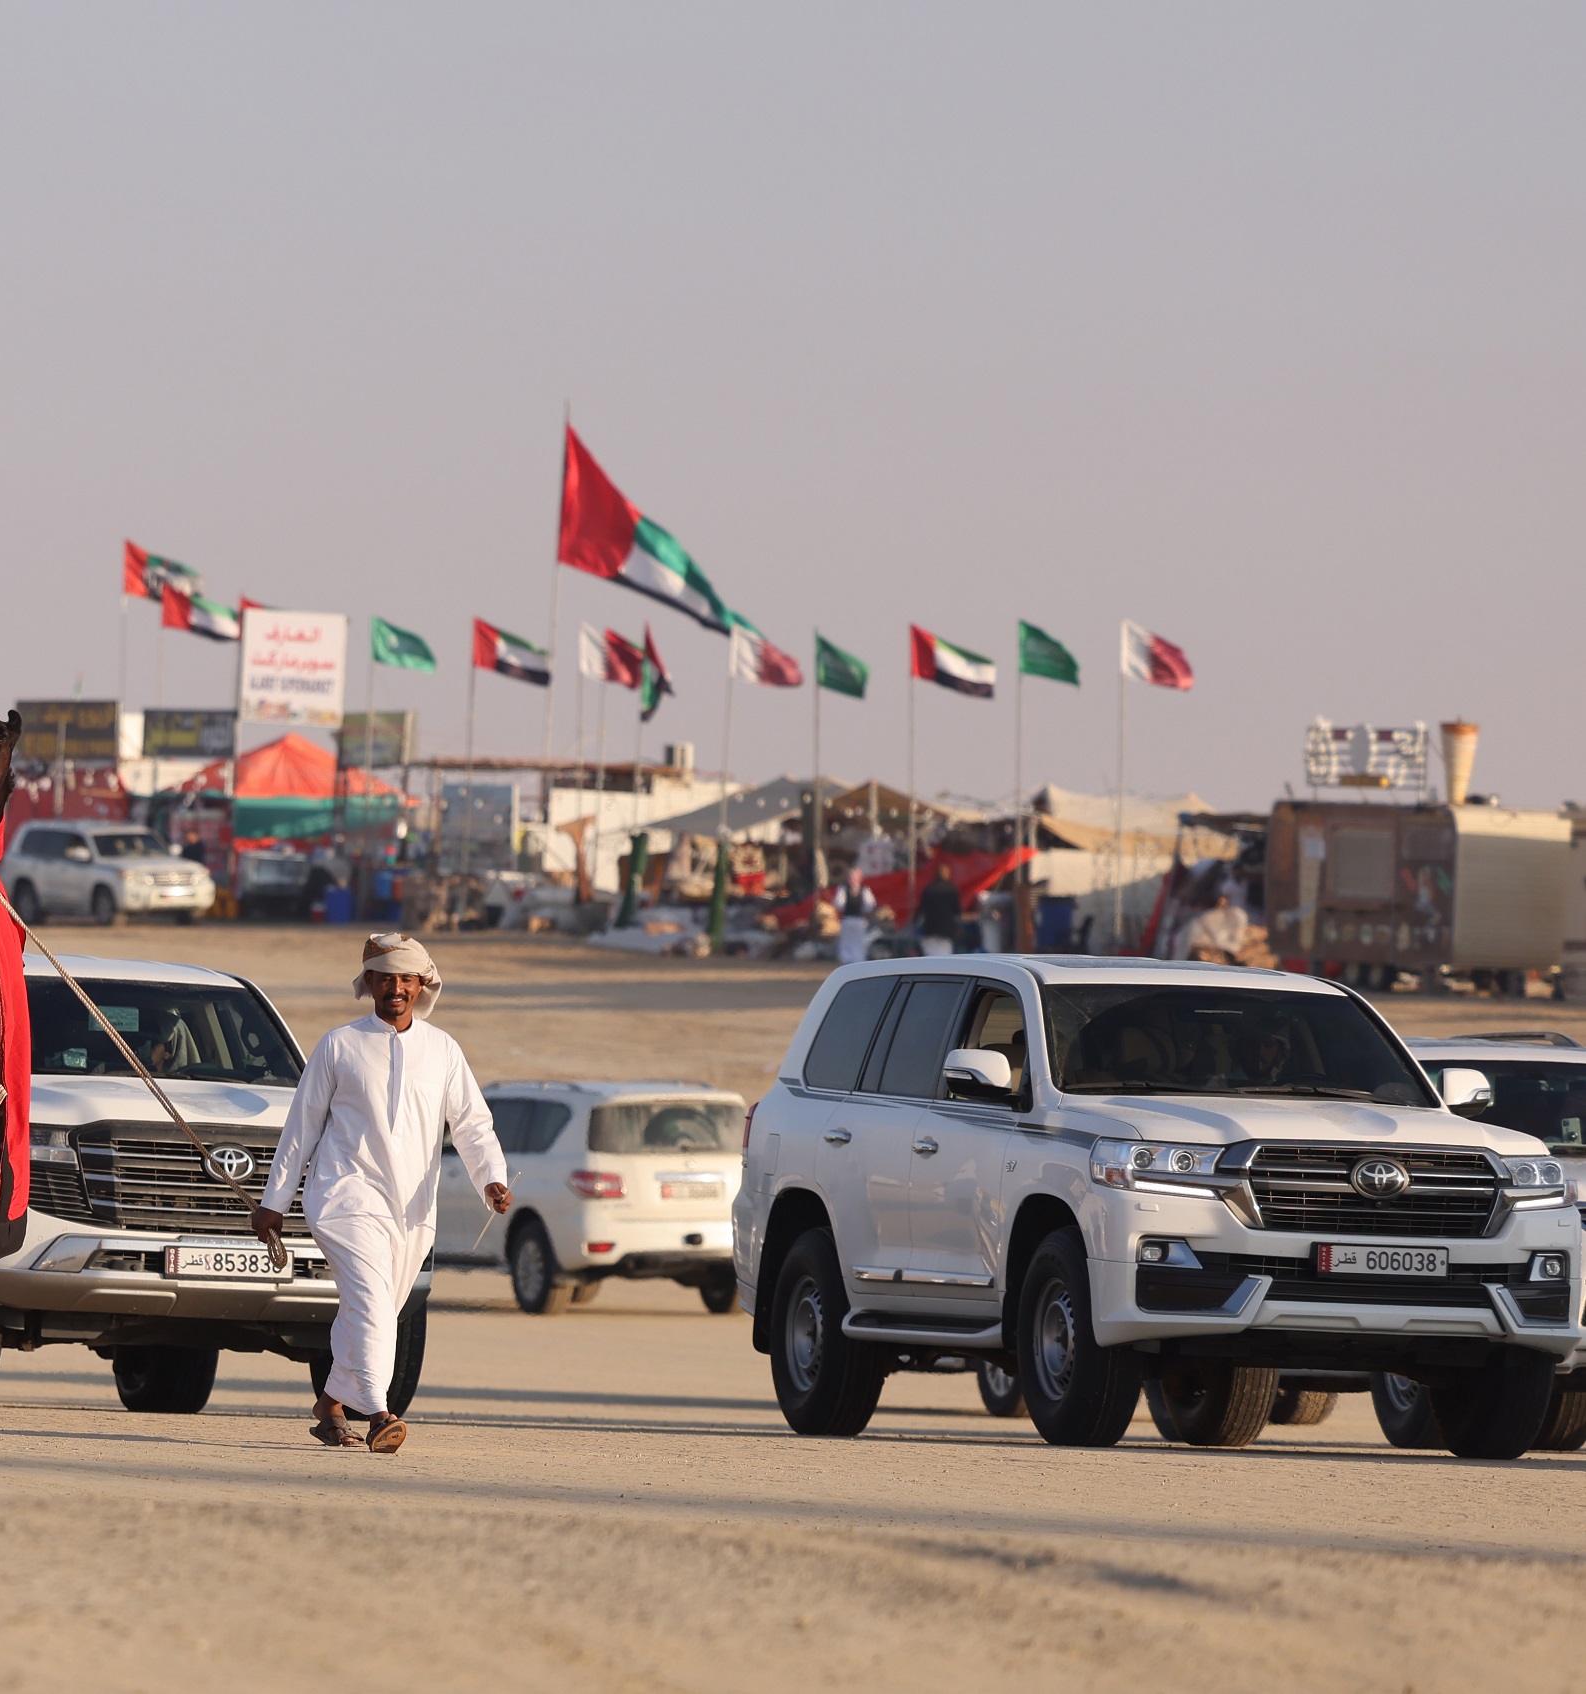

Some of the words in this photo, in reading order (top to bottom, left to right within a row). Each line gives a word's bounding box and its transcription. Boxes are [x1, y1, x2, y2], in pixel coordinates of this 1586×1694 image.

[180, 1254, 203, 1268] قطر
[1332, 1251, 1357, 1267] قطر
[1366, 1251, 1437, 1272] 606038
